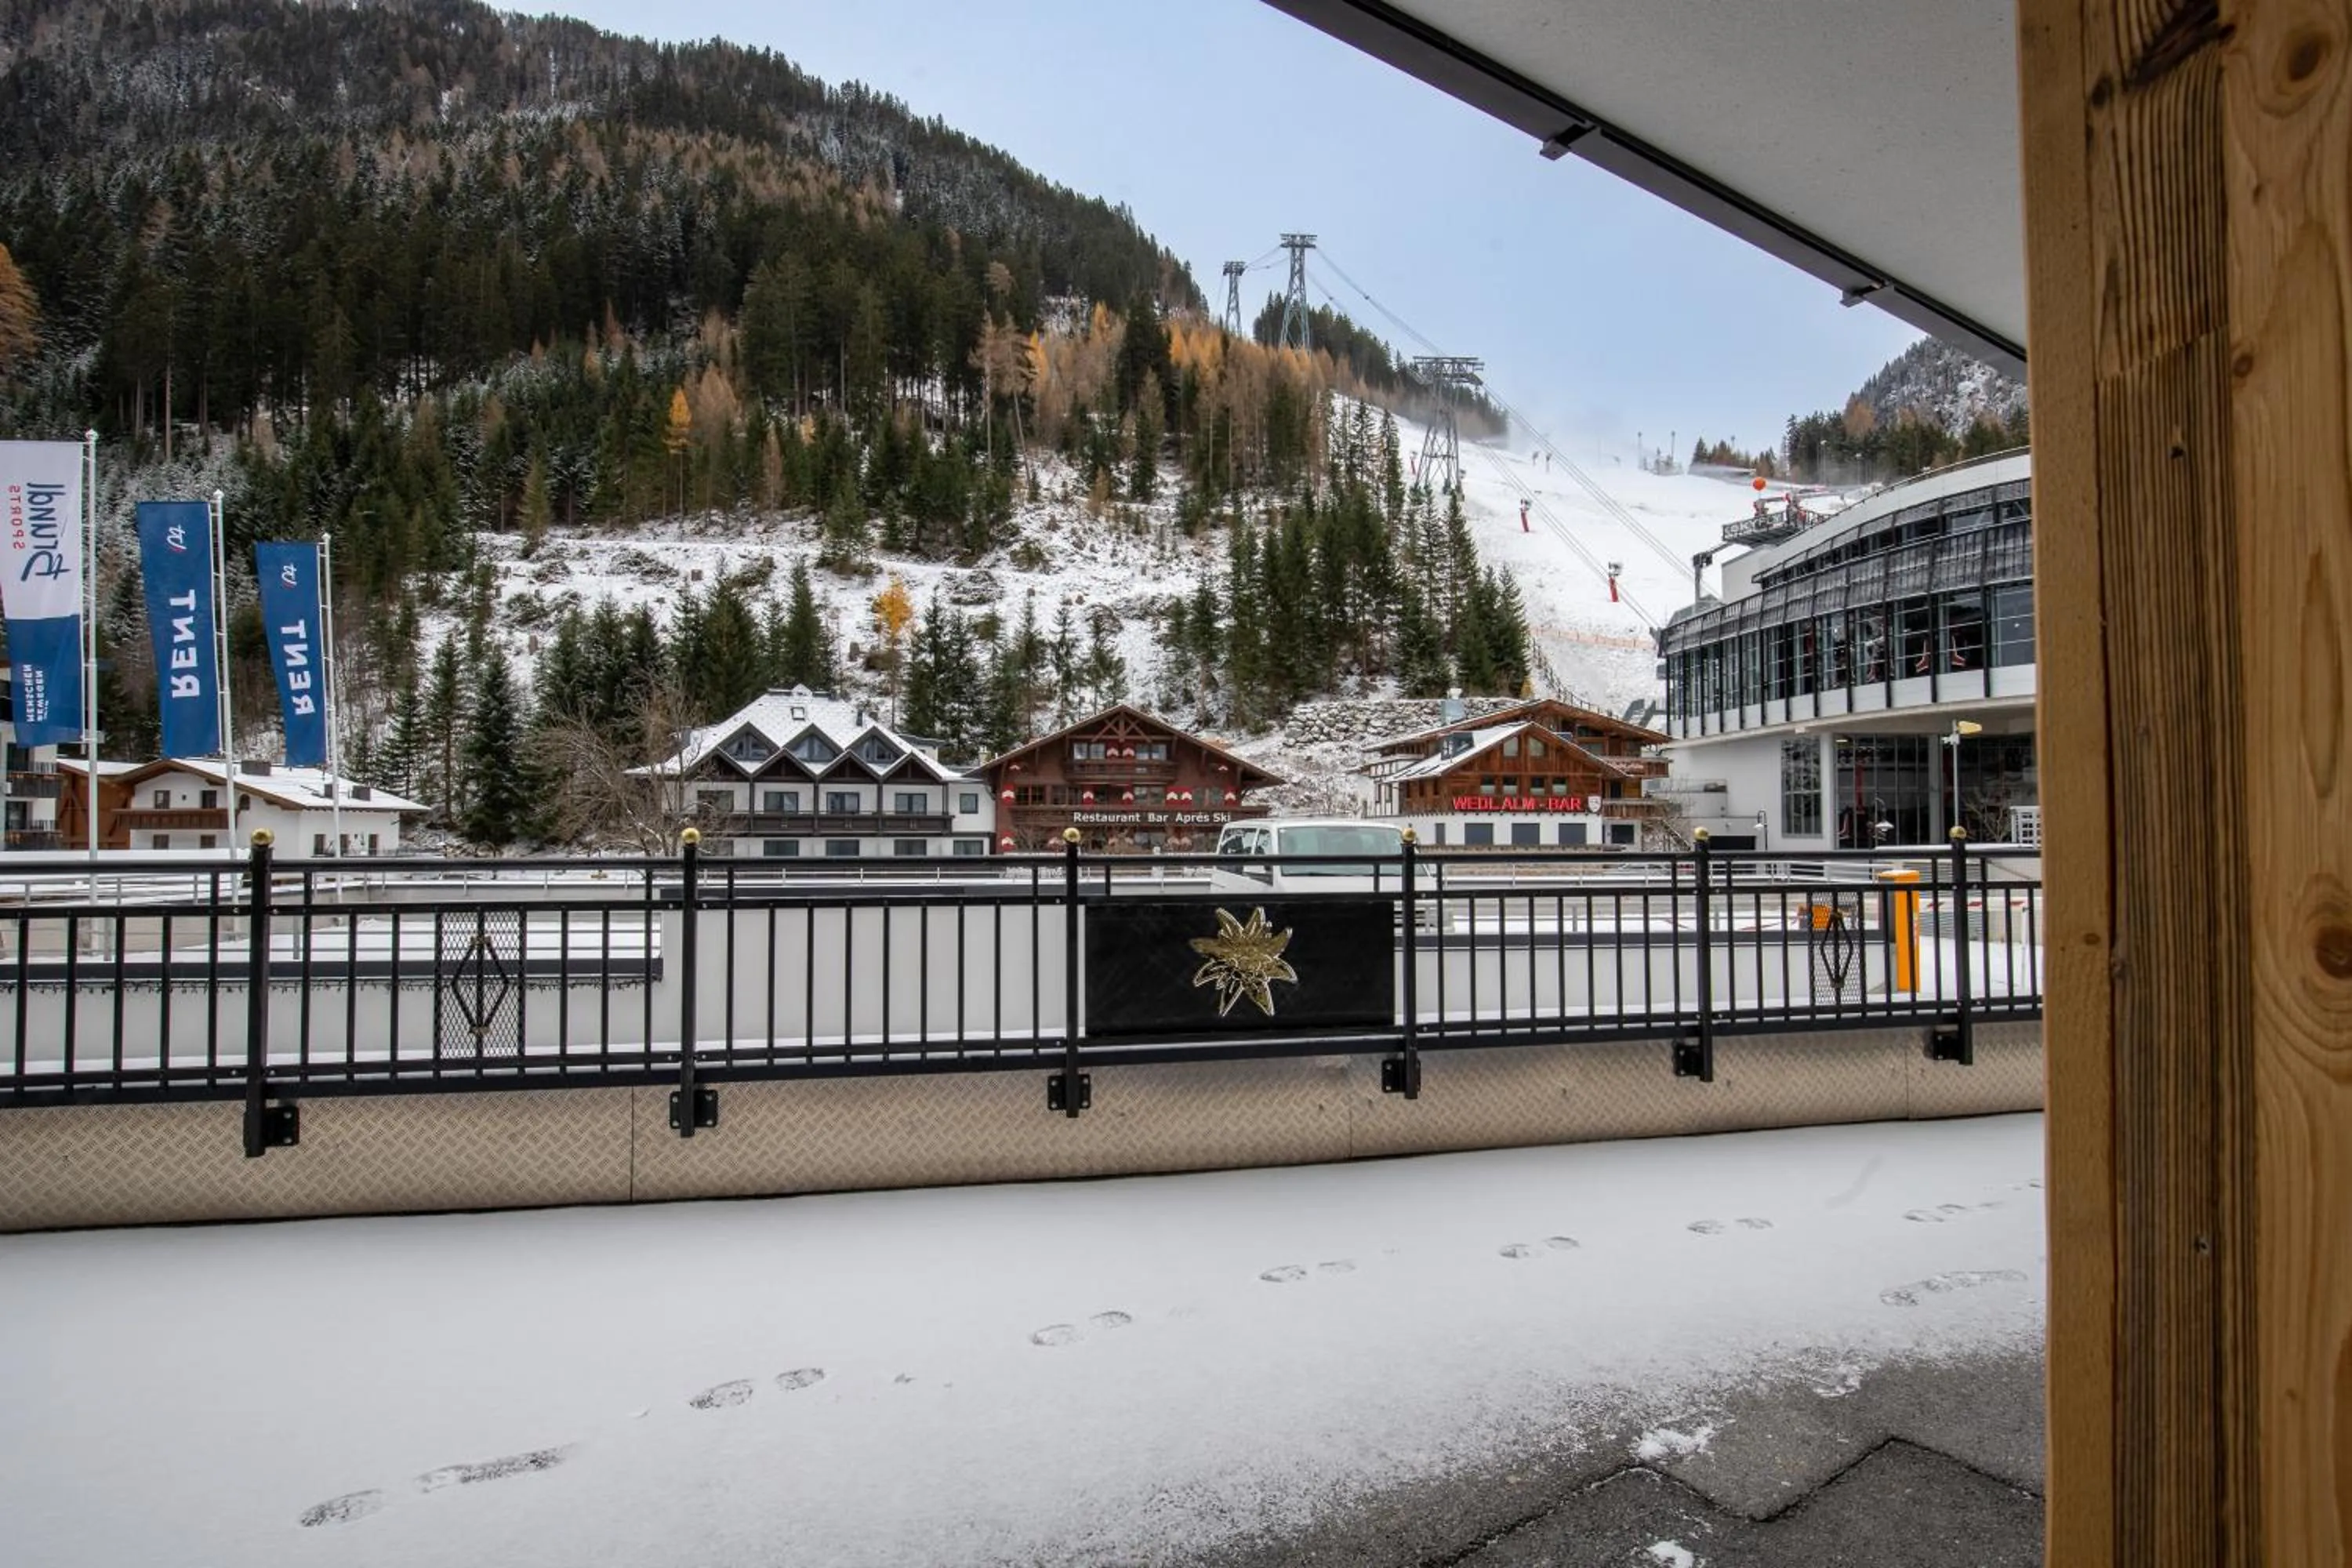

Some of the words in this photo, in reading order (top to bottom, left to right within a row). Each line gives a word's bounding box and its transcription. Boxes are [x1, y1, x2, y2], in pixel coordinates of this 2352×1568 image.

[1073, 811, 1141, 822] Restaurant
[1147, 812, 1169, 822] Bar
[1213, 812, 1231, 822] Ski
